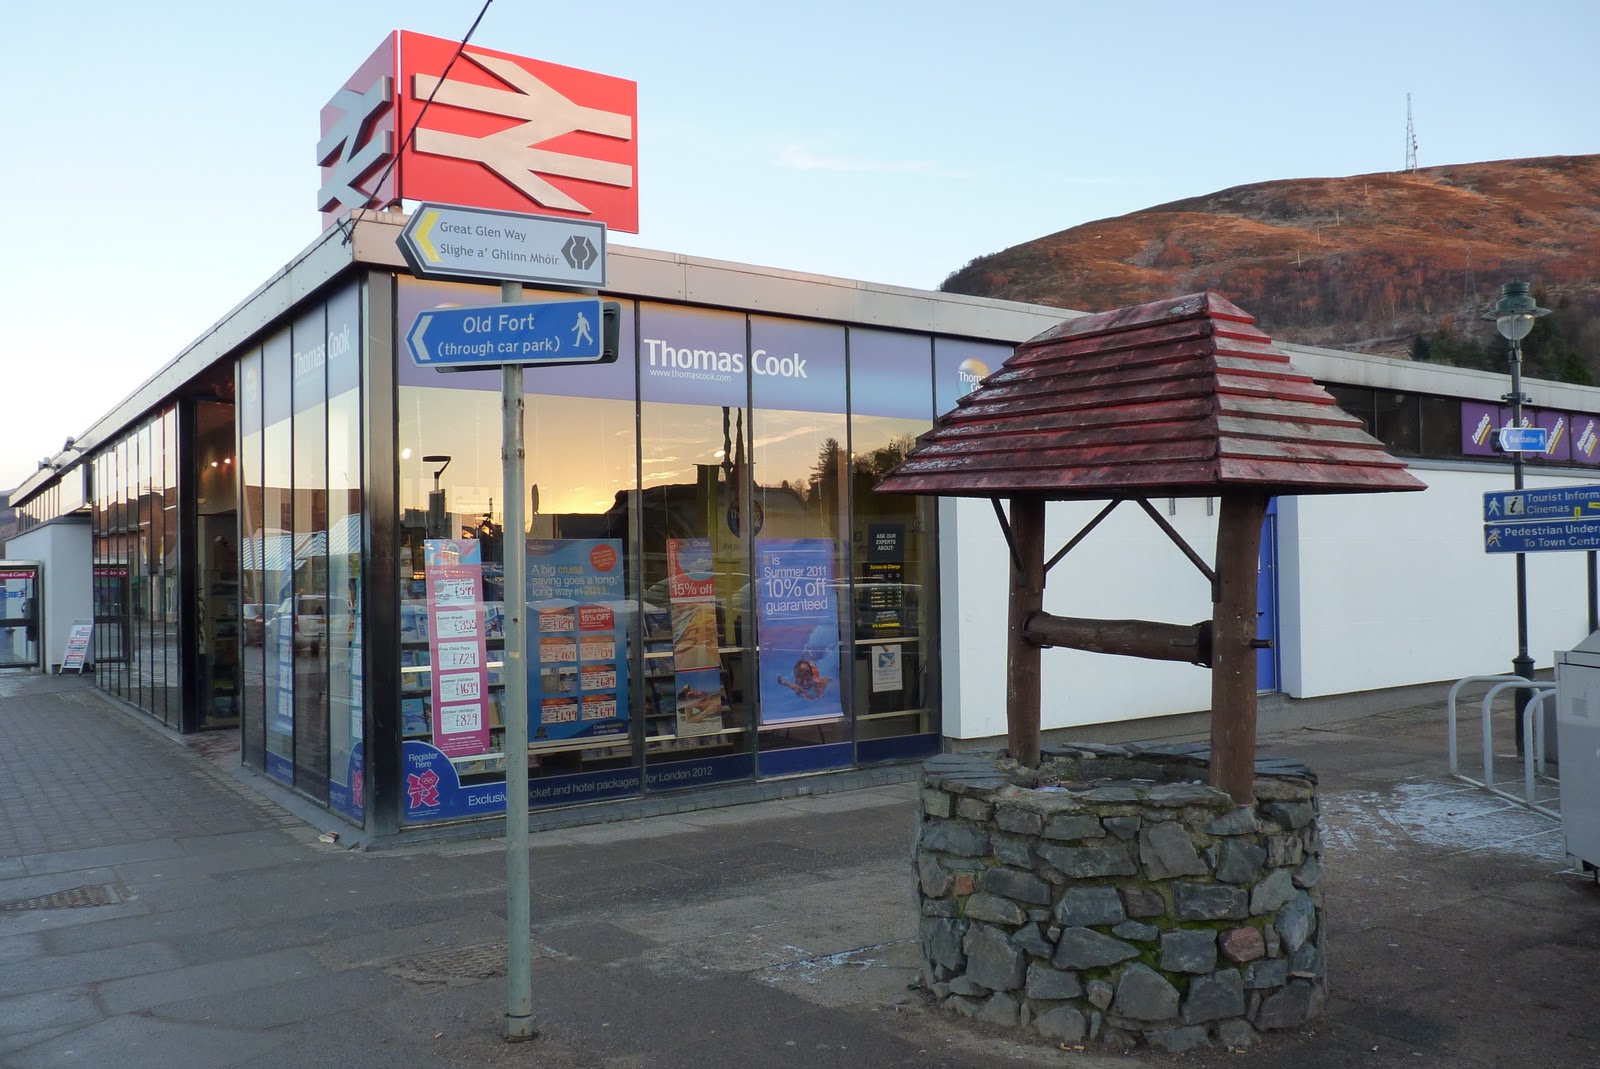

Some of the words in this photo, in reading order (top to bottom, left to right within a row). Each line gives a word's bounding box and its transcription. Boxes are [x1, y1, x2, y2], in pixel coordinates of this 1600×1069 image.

[440, 222, 472, 235] Great
[475, 225, 501, 238] Glen
[504, 229, 527, 243] Way
[440, 244, 474, 258] Slighe
[492, 249, 527, 263] Ghlinn
[463, 316, 492, 334] Old
[498, 313, 535, 331] Fort
[293, 343, 325, 378] Thomas
[328, 324, 350, 360] Cook
[438, 341, 494, 357] (through
[498, 340, 518, 353] car
[523, 336, 561, 354] park)
[644, 338, 744, 373] Thomas
[751, 349, 808, 378] Cook
[649, 369, 731, 382] www.thomascook.com
[1526, 493, 1562, 503] Tourist
[1526, 505, 1570, 514] Cinemas
[1504, 525, 1563, 537] Pedestrian
[1565, 524, 1600, 534] Under
[1524, 538, 1535, 547] To
[1538, 537, 1566, 546] Town
[771, 554, 780, 565] is
[532, 565, 540, 574] A
[541, 565, 556, 576] big
[557, 566, 583, 574] cruise
[764, 566, 805, 578] Summer
[806, 566, 827, 577] 2011
[532, 577, 561, 587] saving
[563, 578, 585, 587] goes
[765, 578, 802, 598] 10%
[805, 577, 827, 597] off
[532, 587, 553, 598] long
[555, 588, 573, 598] way
[574, 587, 583, 595] in
[672, 583, 697, 596] 15%
[699, 584, 712, 595] off
[580, 607, 611, 615] guaranteed
[765, 597, 828, 615] guaranteed
[581, 614, 596, 622] 15%
[596, 613, 611, 621] OFF
[408, 752, 438, 762] Register
[415, 761, 432, 769] here
[468, 793, 507, 806] Exclusiv
[528, 786, 551, 799] icket
[553, 782, 571, 795] and
[572, 779, 595, 793] hotel
[596, 776, 640, 792] packages
[646, 773, 658, 783] for
[658, 770, 691, 782] London
[692, 766, 713, 778] 2012
